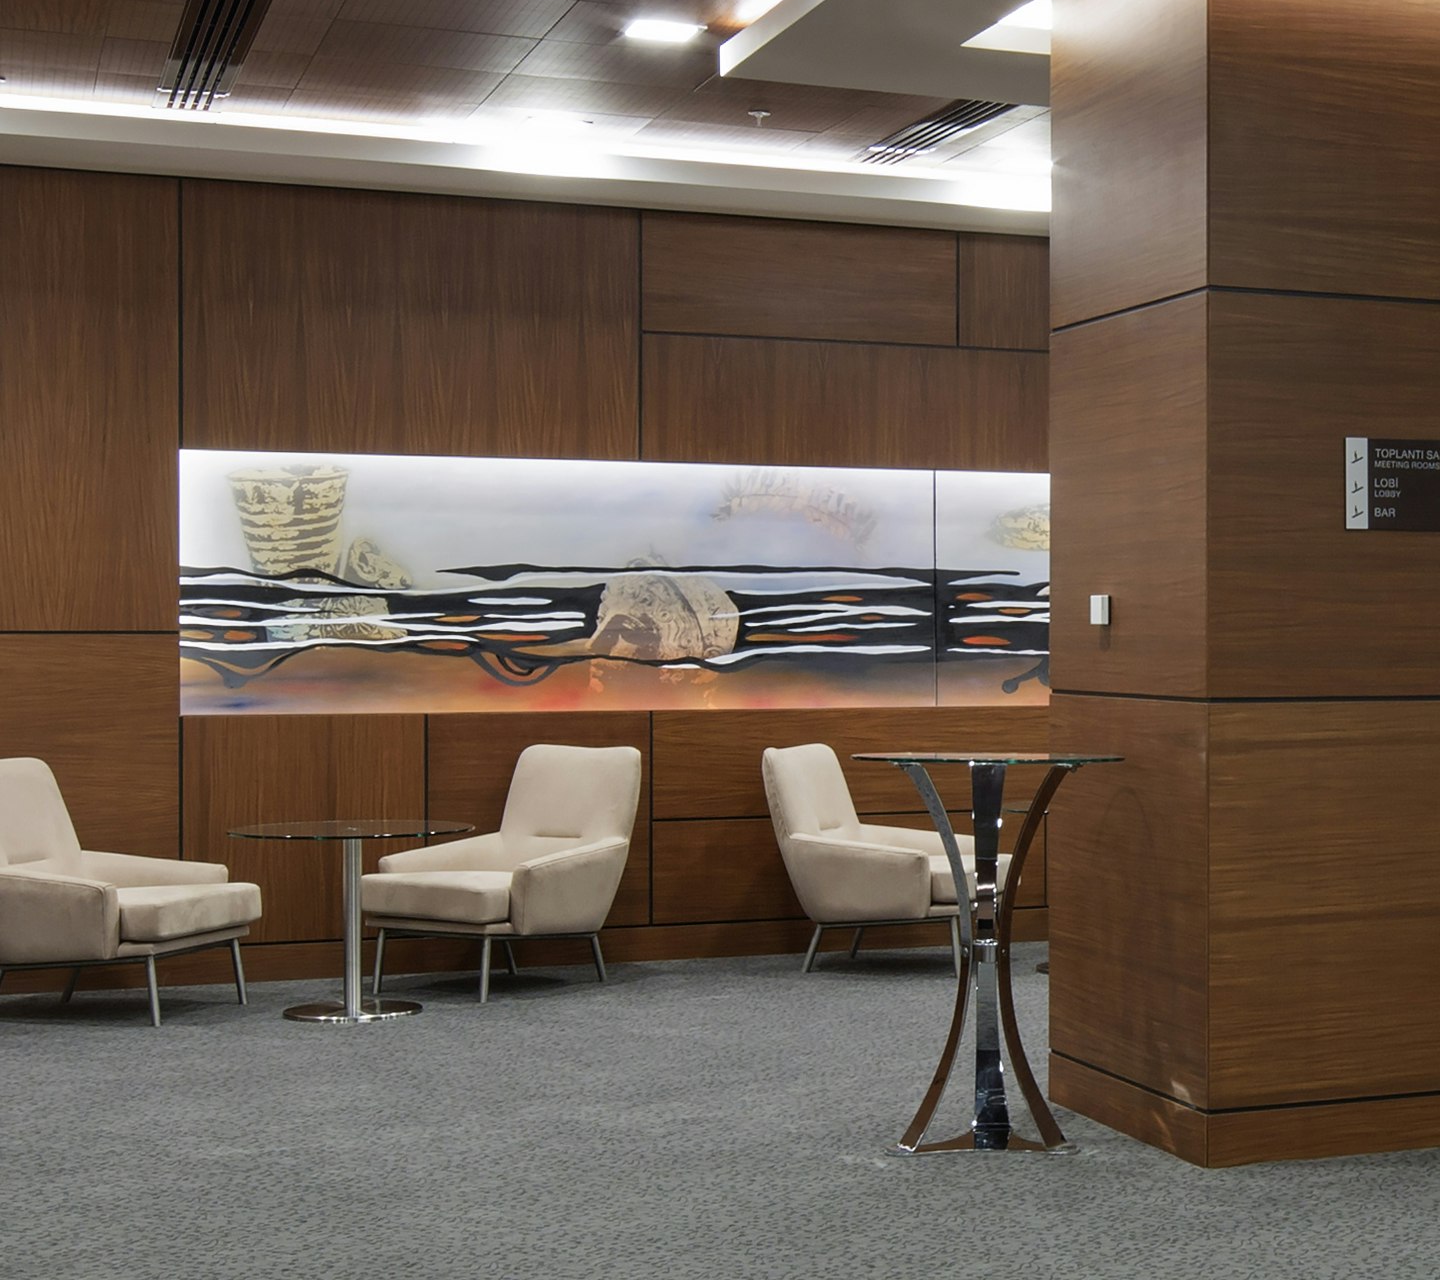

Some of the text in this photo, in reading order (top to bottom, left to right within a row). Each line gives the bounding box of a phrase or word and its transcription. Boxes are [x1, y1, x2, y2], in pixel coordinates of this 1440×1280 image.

[1375, 448, 1424, 459] TOPLANTI
[1374, 460, 1440, 470] MEETING ROOMS
[1374, 490, 1401, 498] LOBBY
[1374, 507, 1396, 518] BAR
